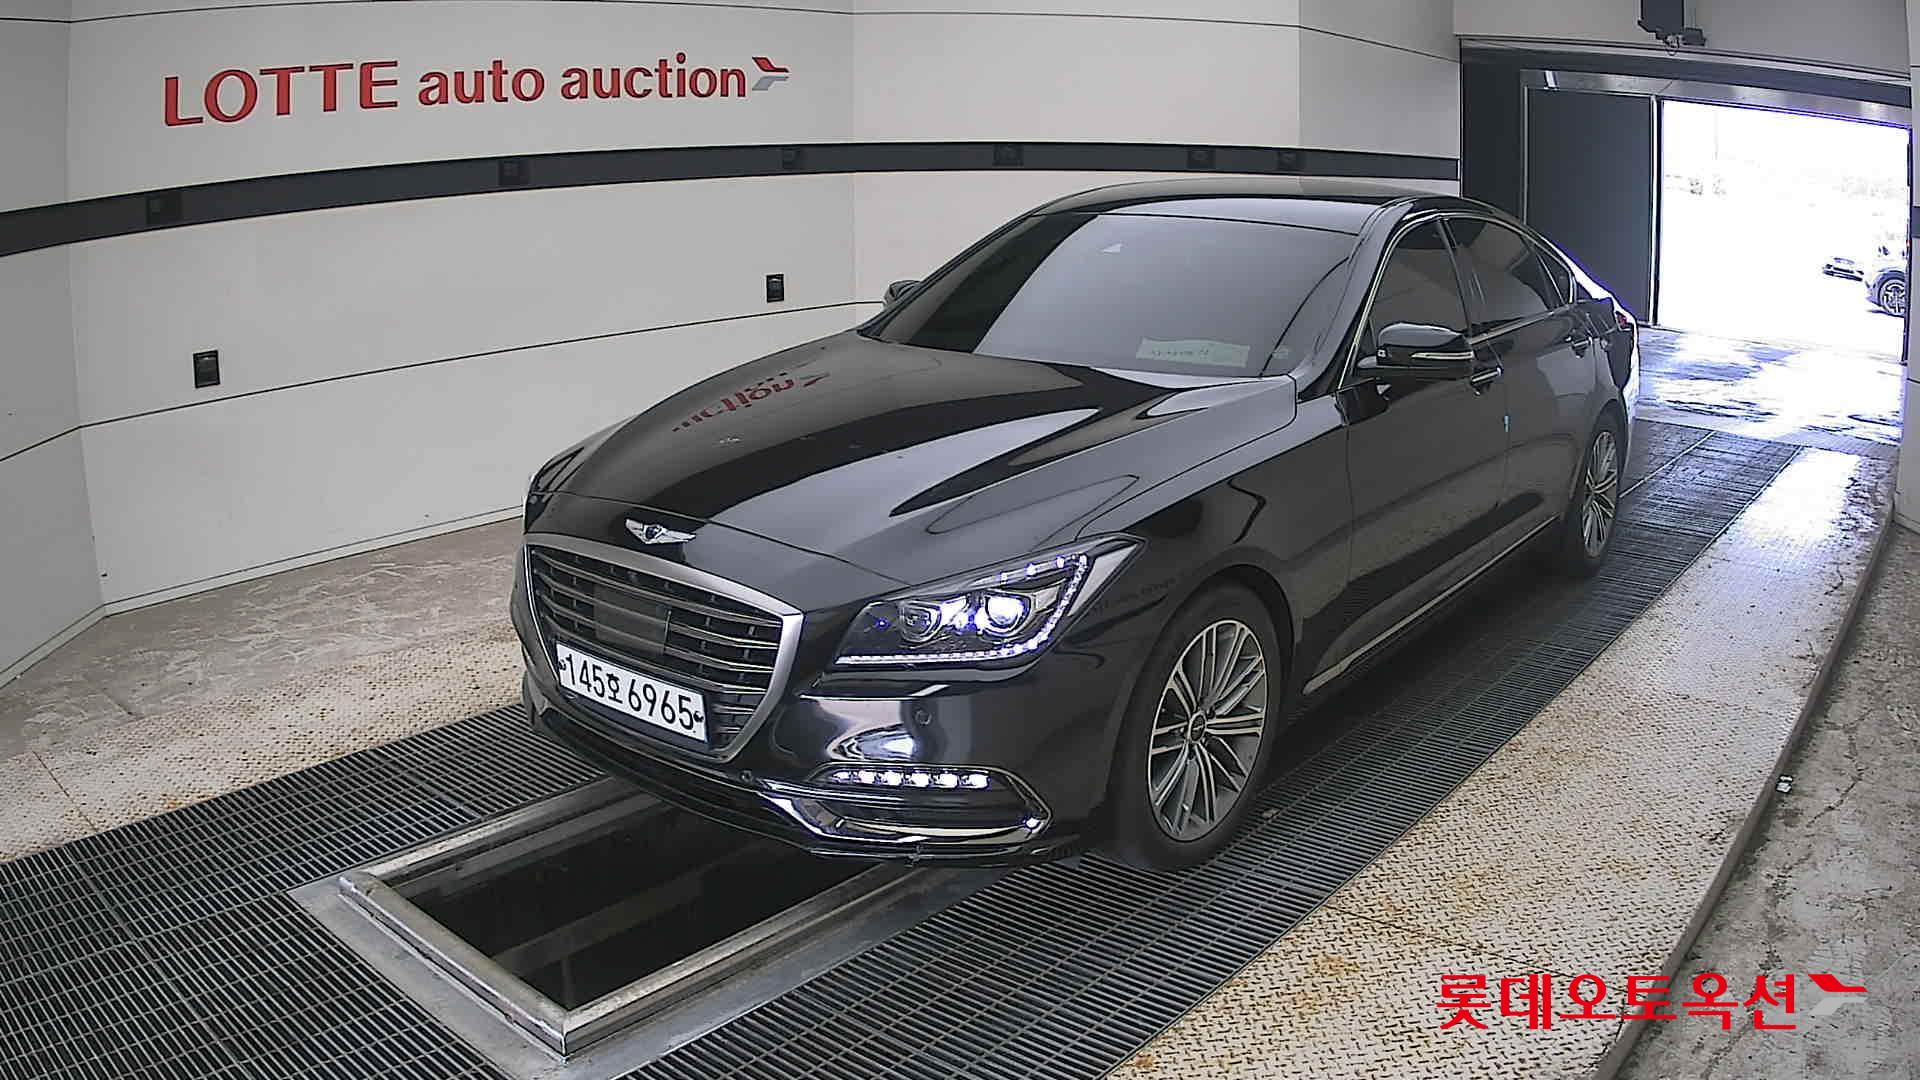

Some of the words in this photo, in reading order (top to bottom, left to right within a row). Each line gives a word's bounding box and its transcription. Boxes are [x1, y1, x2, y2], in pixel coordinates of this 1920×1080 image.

[163, 60, 399, 127] LOTTE
[418, 59, 546, 106] auto
[560, 52, 747, 100] auction
